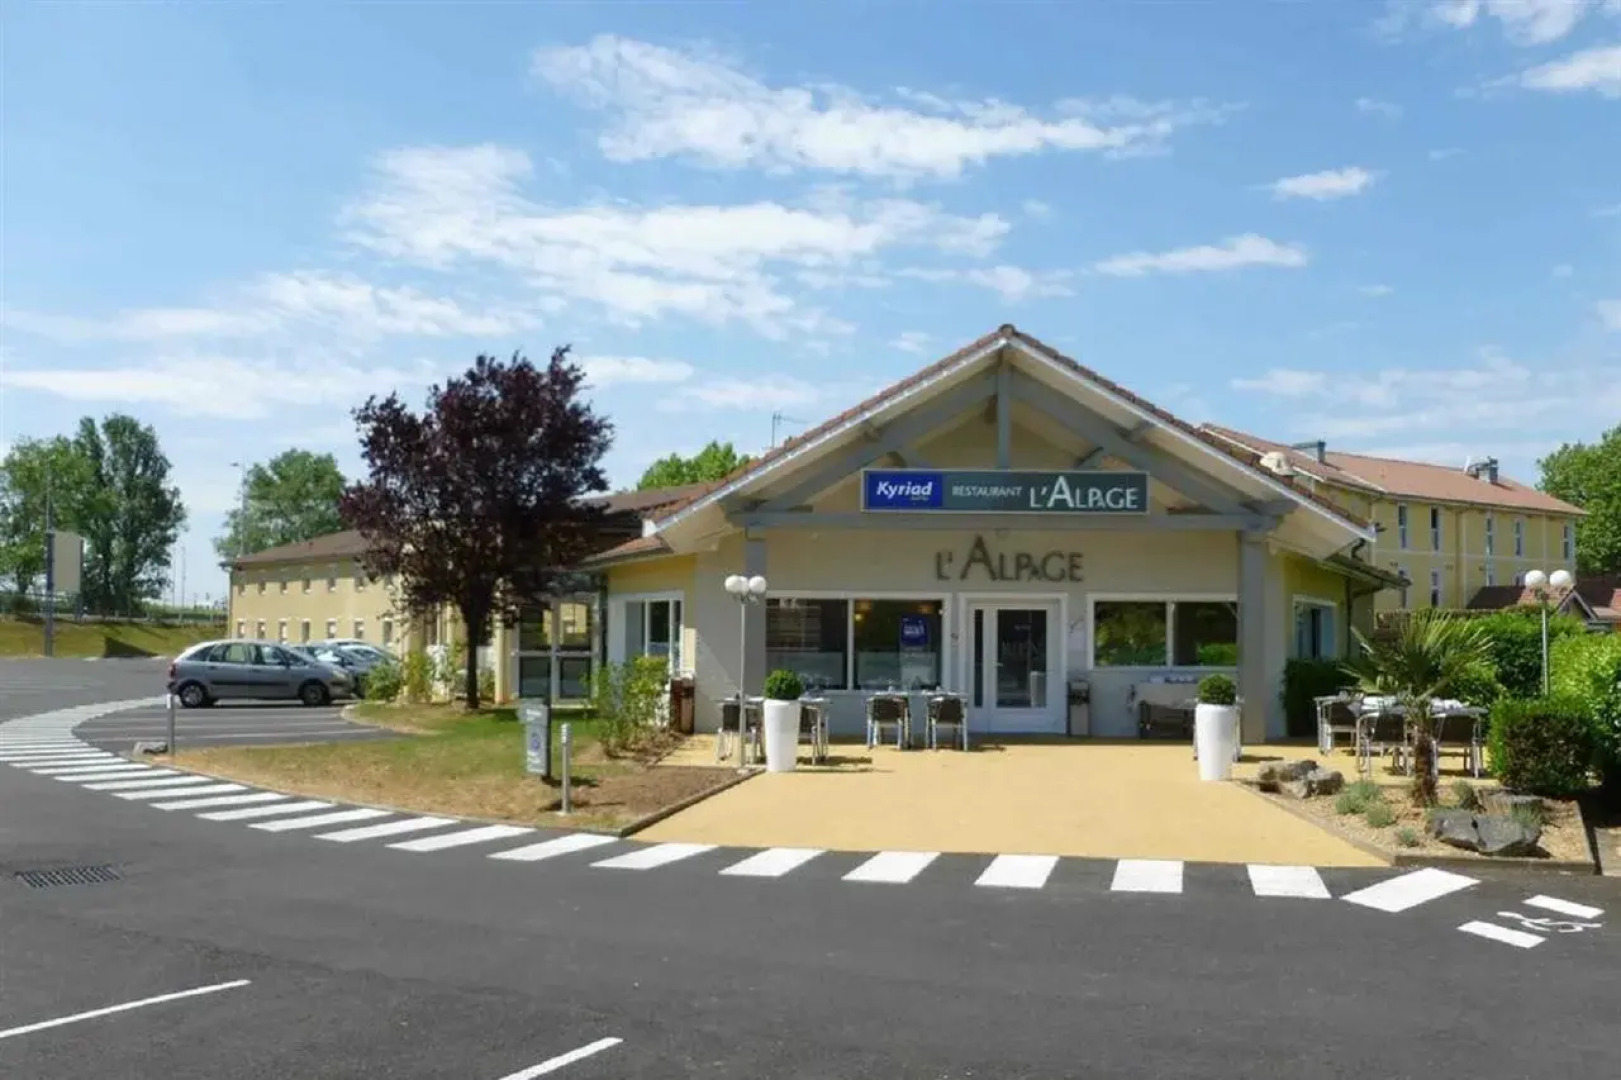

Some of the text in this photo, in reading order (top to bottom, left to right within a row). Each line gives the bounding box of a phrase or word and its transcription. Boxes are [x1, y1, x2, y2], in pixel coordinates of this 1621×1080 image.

[876, 481, 933, 500] Kyriad
[952, 475, 1138, 509] RESTAURANT L'ALPAGE
